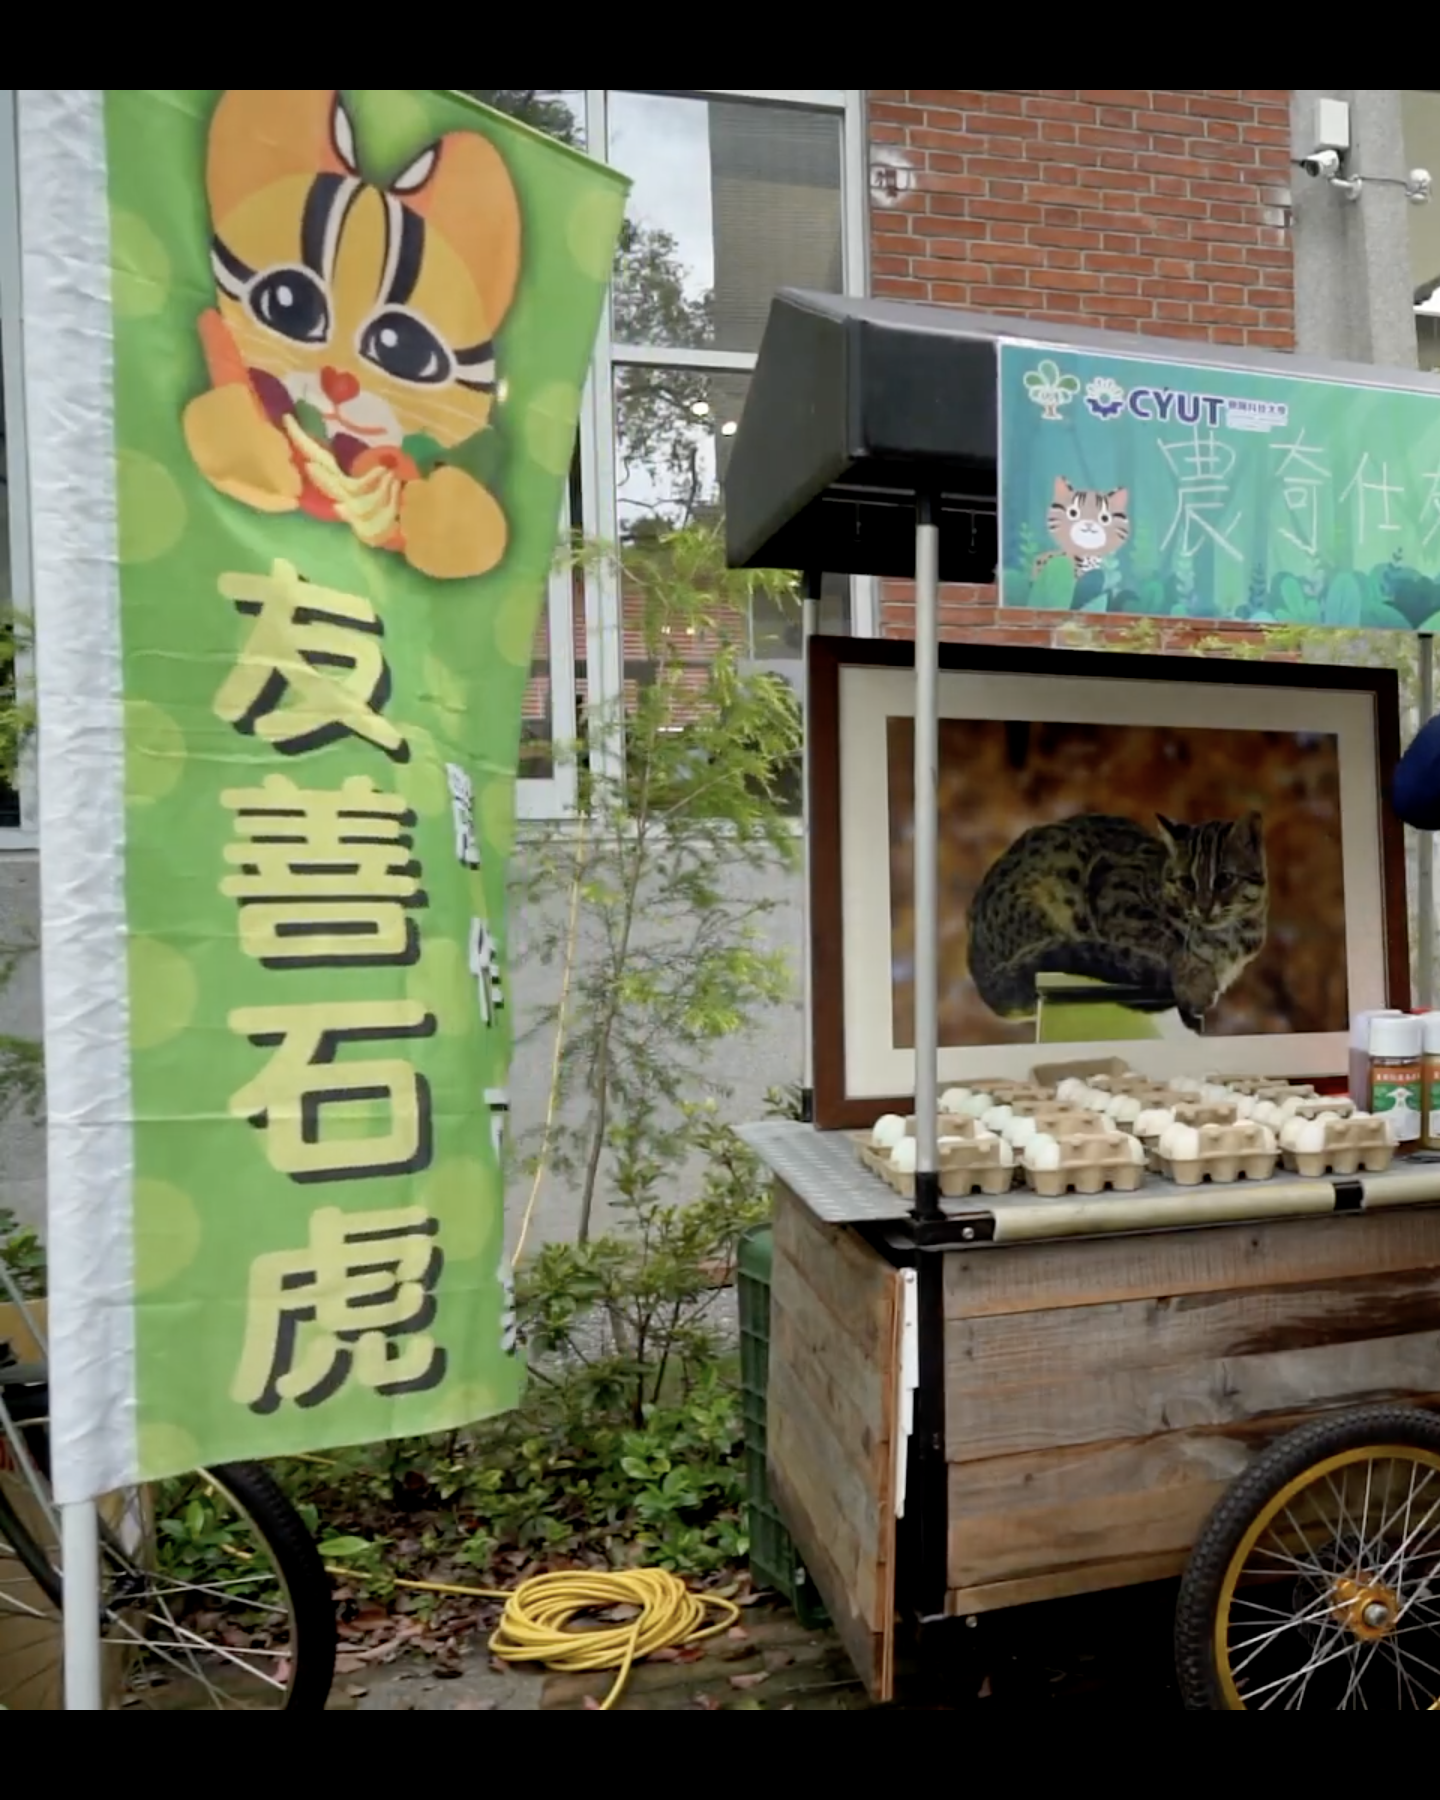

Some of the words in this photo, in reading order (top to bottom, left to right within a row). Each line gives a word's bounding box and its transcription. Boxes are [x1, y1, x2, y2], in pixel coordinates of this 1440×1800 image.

[1128, 388, 1225, 426] CYUT
[214, 557, 447, 1415] 友善石虎
